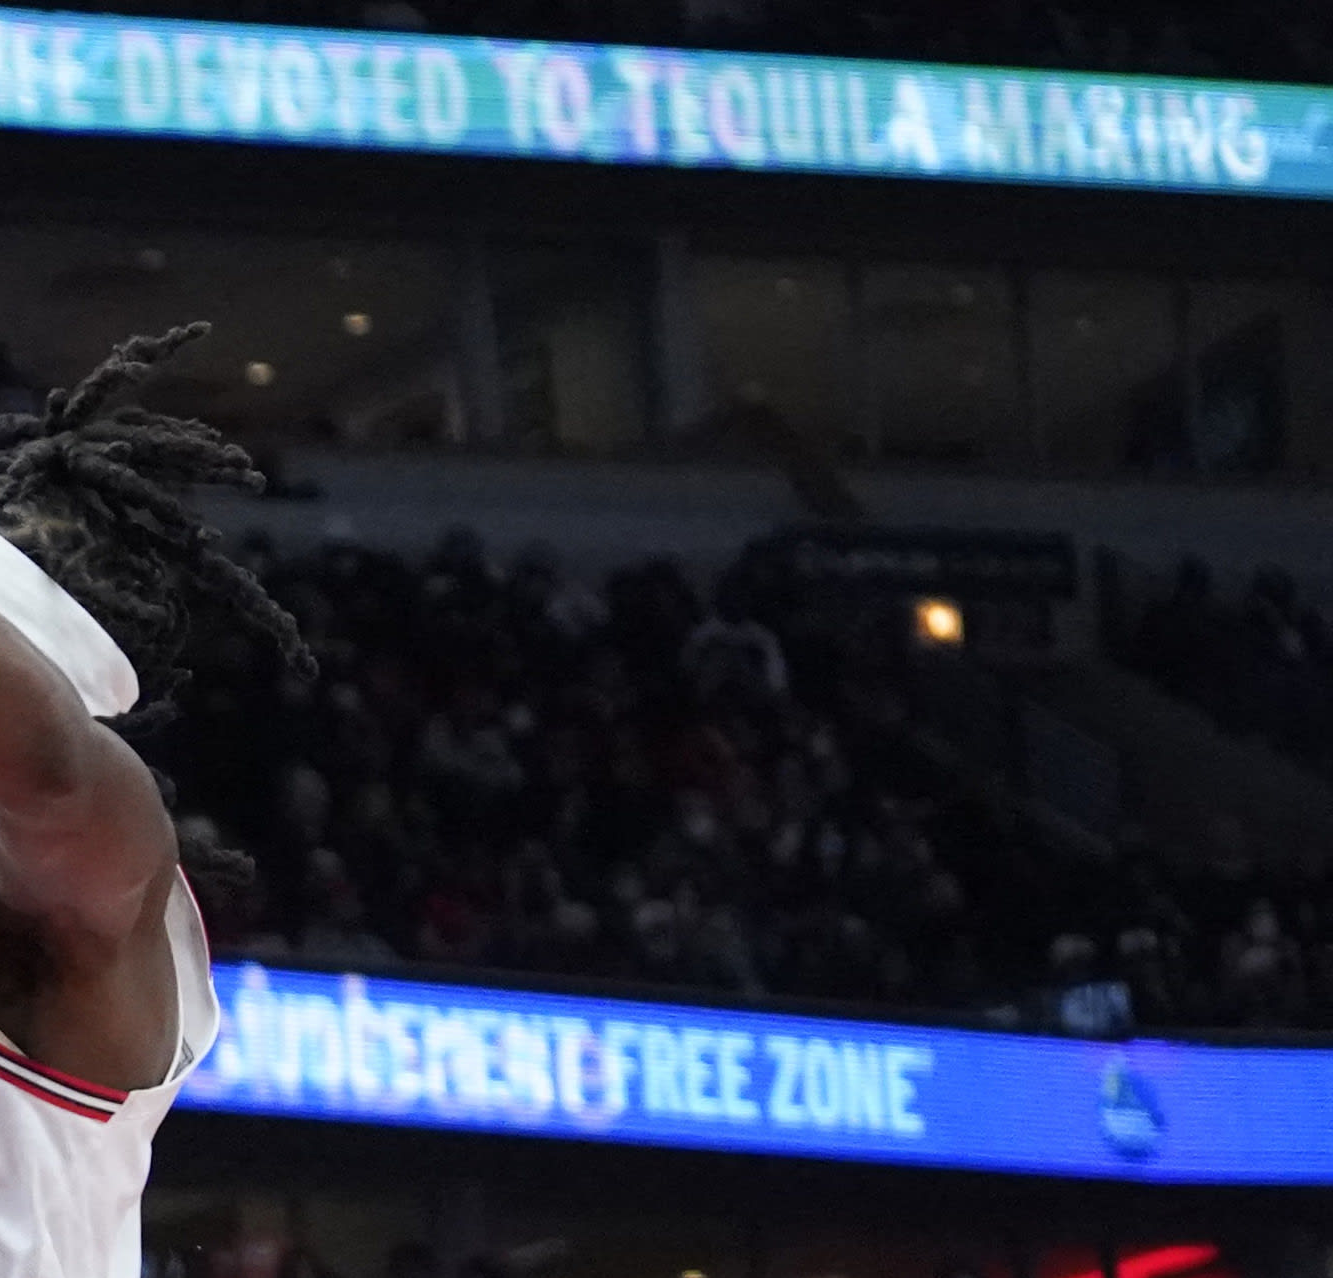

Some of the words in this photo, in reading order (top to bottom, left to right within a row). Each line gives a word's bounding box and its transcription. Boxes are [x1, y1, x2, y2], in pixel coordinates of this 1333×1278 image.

[117, 28, 470, 148] DEVOTED
[490, 48, 593, 154] TO
[613, 52, 941, 174] TEQUILA
[961, 76, 1271, 186] MAKING
[601, 1018, 761, 1122] FREE
[765, 1032, 937, 1140] ZONE
